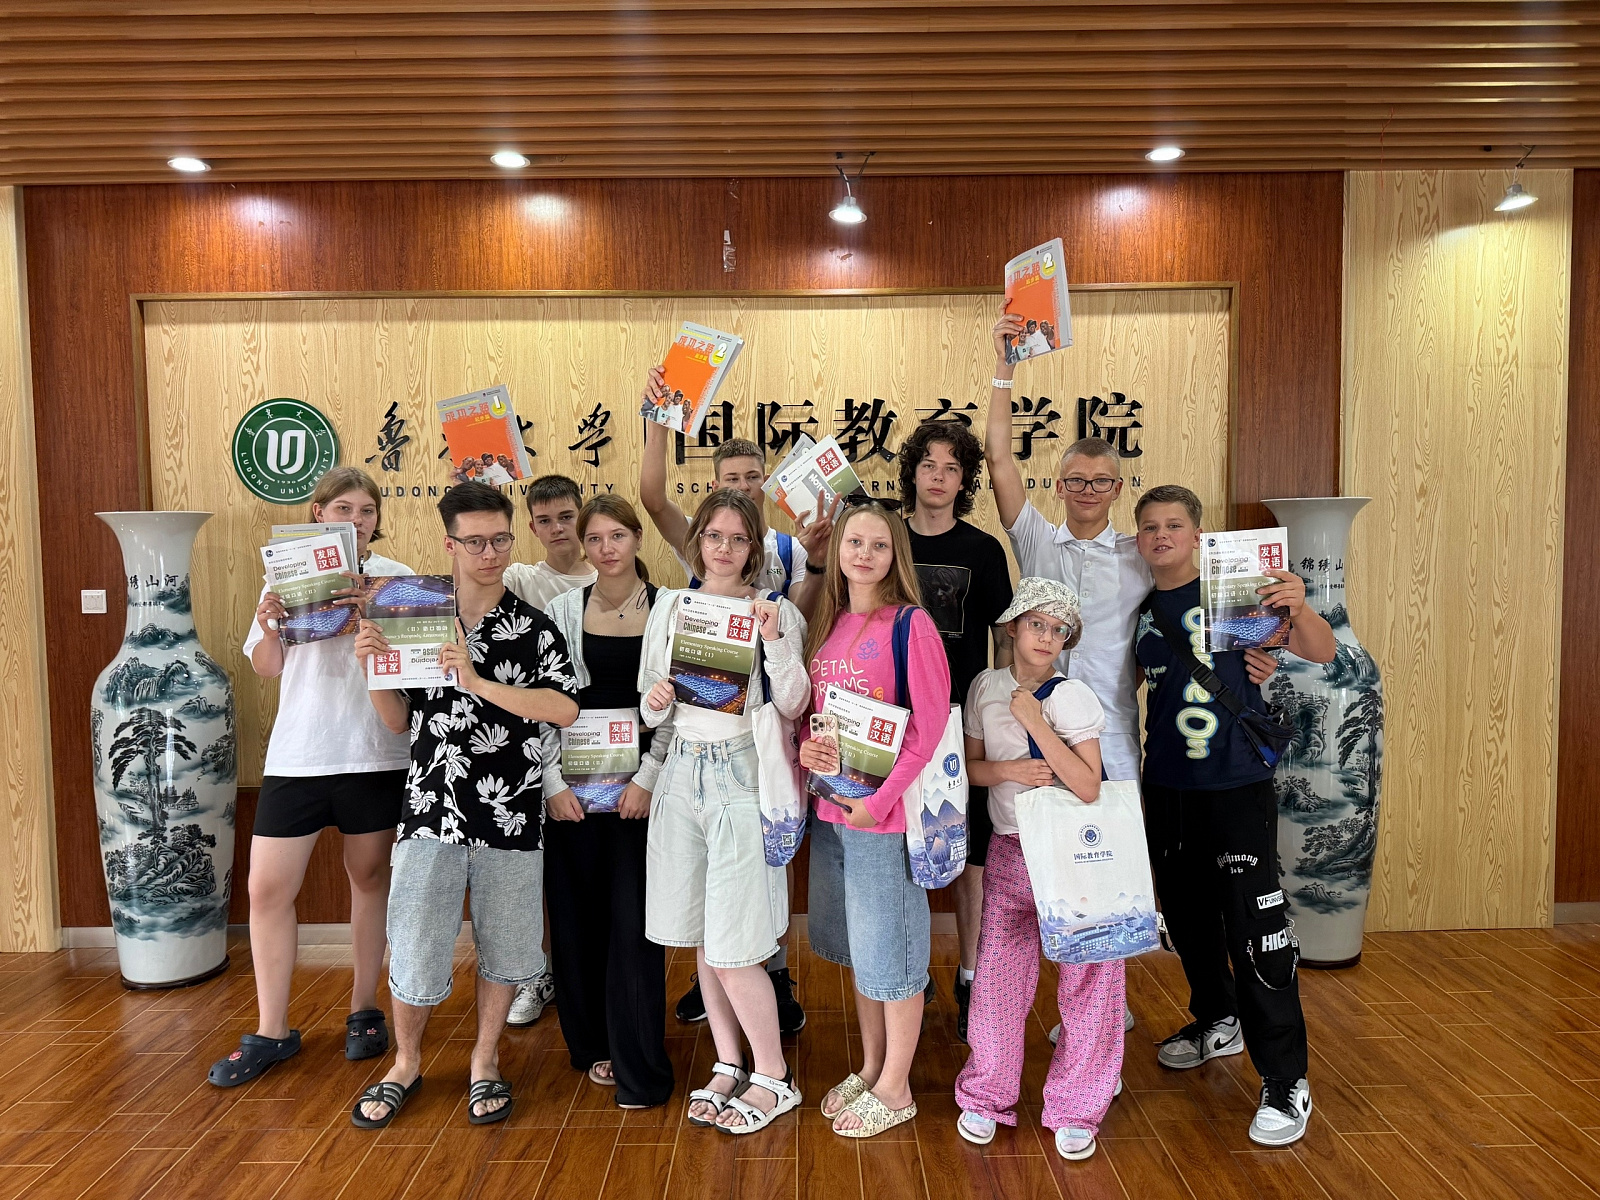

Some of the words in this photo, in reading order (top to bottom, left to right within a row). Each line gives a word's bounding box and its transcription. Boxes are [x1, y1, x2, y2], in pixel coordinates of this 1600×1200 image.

[1043, 252, 1054, 269] 2
[716, 343, 727, 357] 2
[493, 395, 502, 409] 1
[818, 450, 835, 465] 发展
[241, 451, 270, 490] LUDONG
[280, 449, 331, 495] UNIVERSITY
[822, 458, 840, 474] 汉语
[316, 548, 338, 560] 发展
[1260, 545, 1280, 557] 发展
[273, 560, 308, 572] Developing
[318, 557, 340, 569] 汉语
[1260, 557, 1281, 568] 汉语
[274, 569, 299, 581] Chinese
[1211, 564, 1237, 575] Chinese
[684, 614, 719, 628] Developing
[730, 616, 752, 630] 发展
[683, 622, 707, 634] Chinese
[728, 627, 750, 640] 汉语
[680, 639, 703, 649] Elementary
[703, 643, 724, 653] Speaking
[723, 647, 739, 655] Course
[376, 652, 399, 663] 汉语
[376, 662, 399, 674] 发展
[810, 658, 865, 677] PETAL
[611, 723, 631, 733] 发展
[871, 719, 894, 734] 发展
[1175, 706, 1219, 760] On
[568, 737, 591, 746] Chinese
[611, 732, 631, 742] 汉语
[869, 729, 892, 744] 汉语
